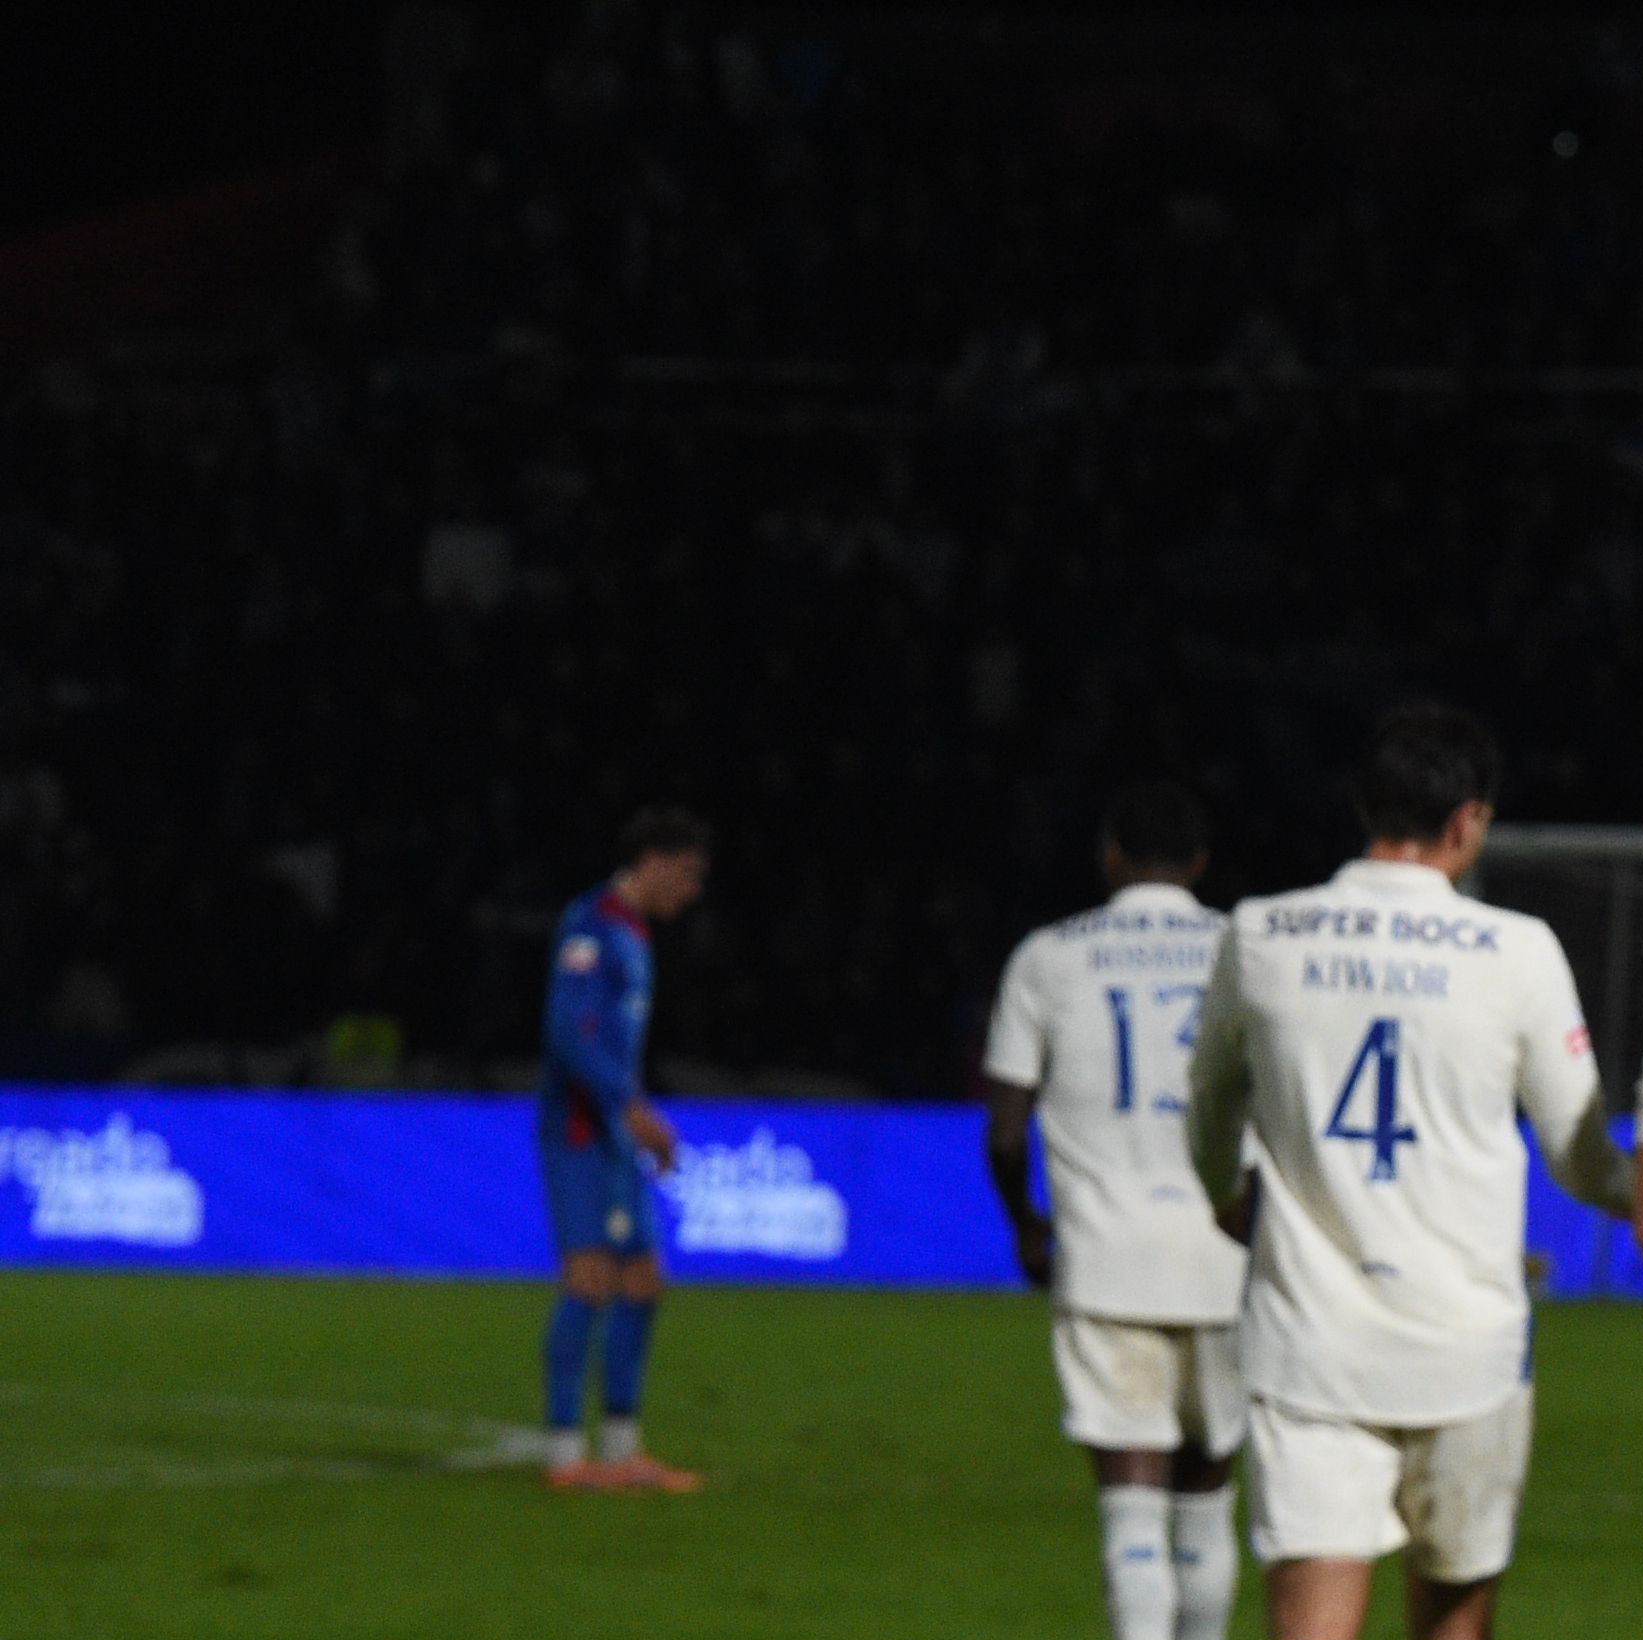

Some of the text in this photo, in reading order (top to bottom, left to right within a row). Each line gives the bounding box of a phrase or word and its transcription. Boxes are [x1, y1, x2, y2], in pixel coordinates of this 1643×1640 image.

[1264, 906, 1501, 953] SUPER BOCK
[1325, 1015, 1418, 1182] 4
